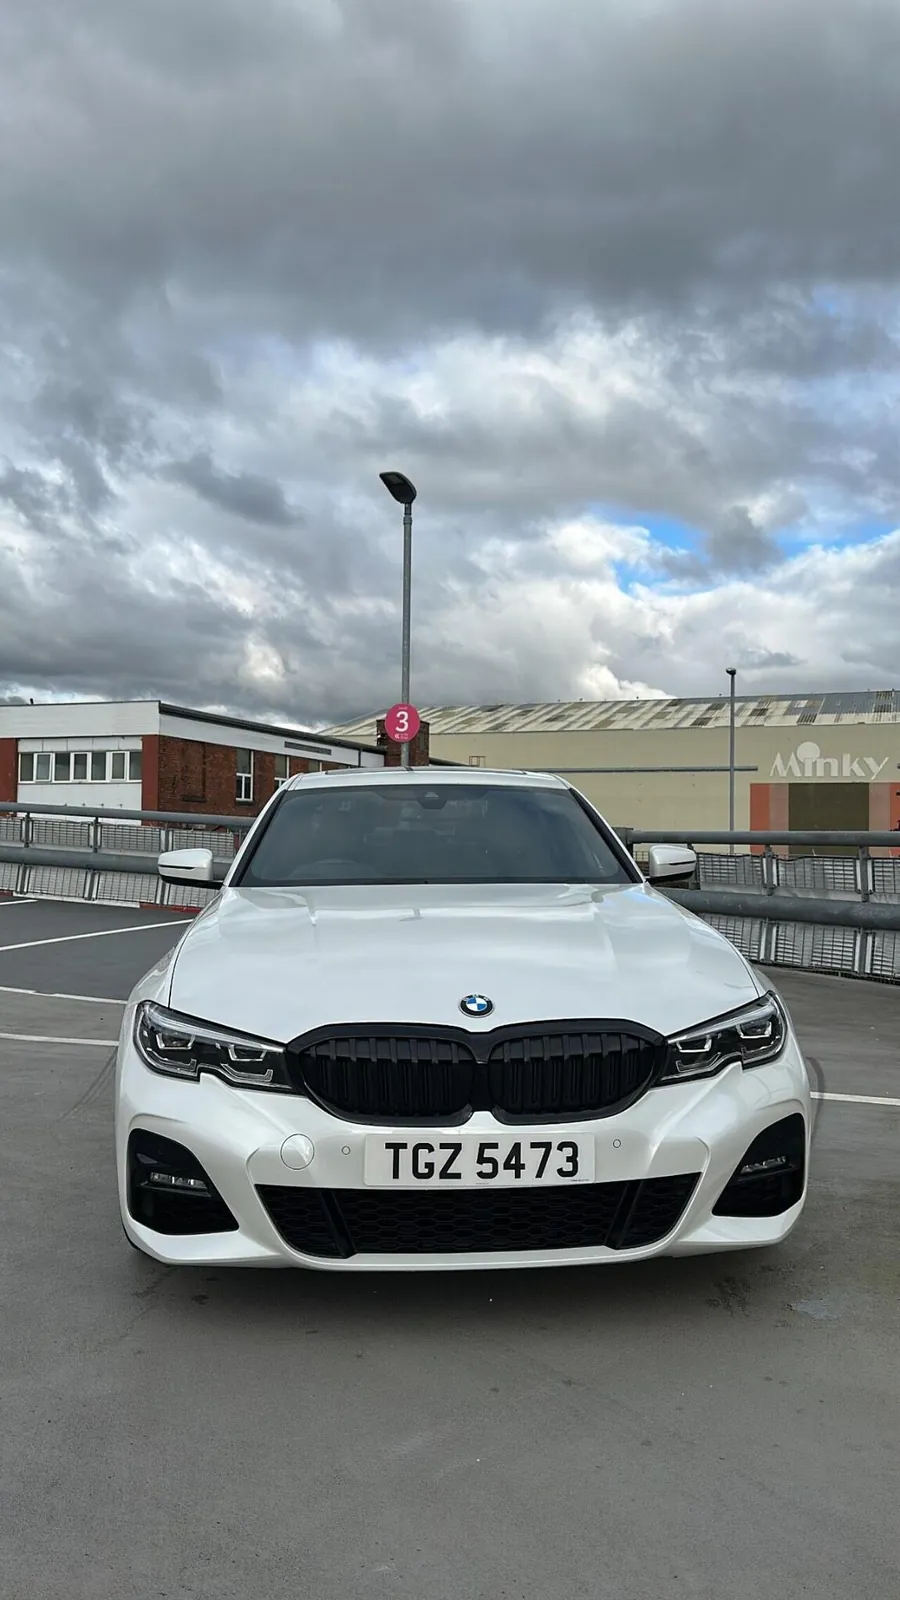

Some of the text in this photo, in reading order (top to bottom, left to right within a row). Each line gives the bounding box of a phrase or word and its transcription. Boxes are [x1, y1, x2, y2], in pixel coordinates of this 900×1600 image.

[395, 711, 409, 732] 3
[769, 741, 889, 780] Minky
[385, 1141, 579, 1180] TGZ 5473
